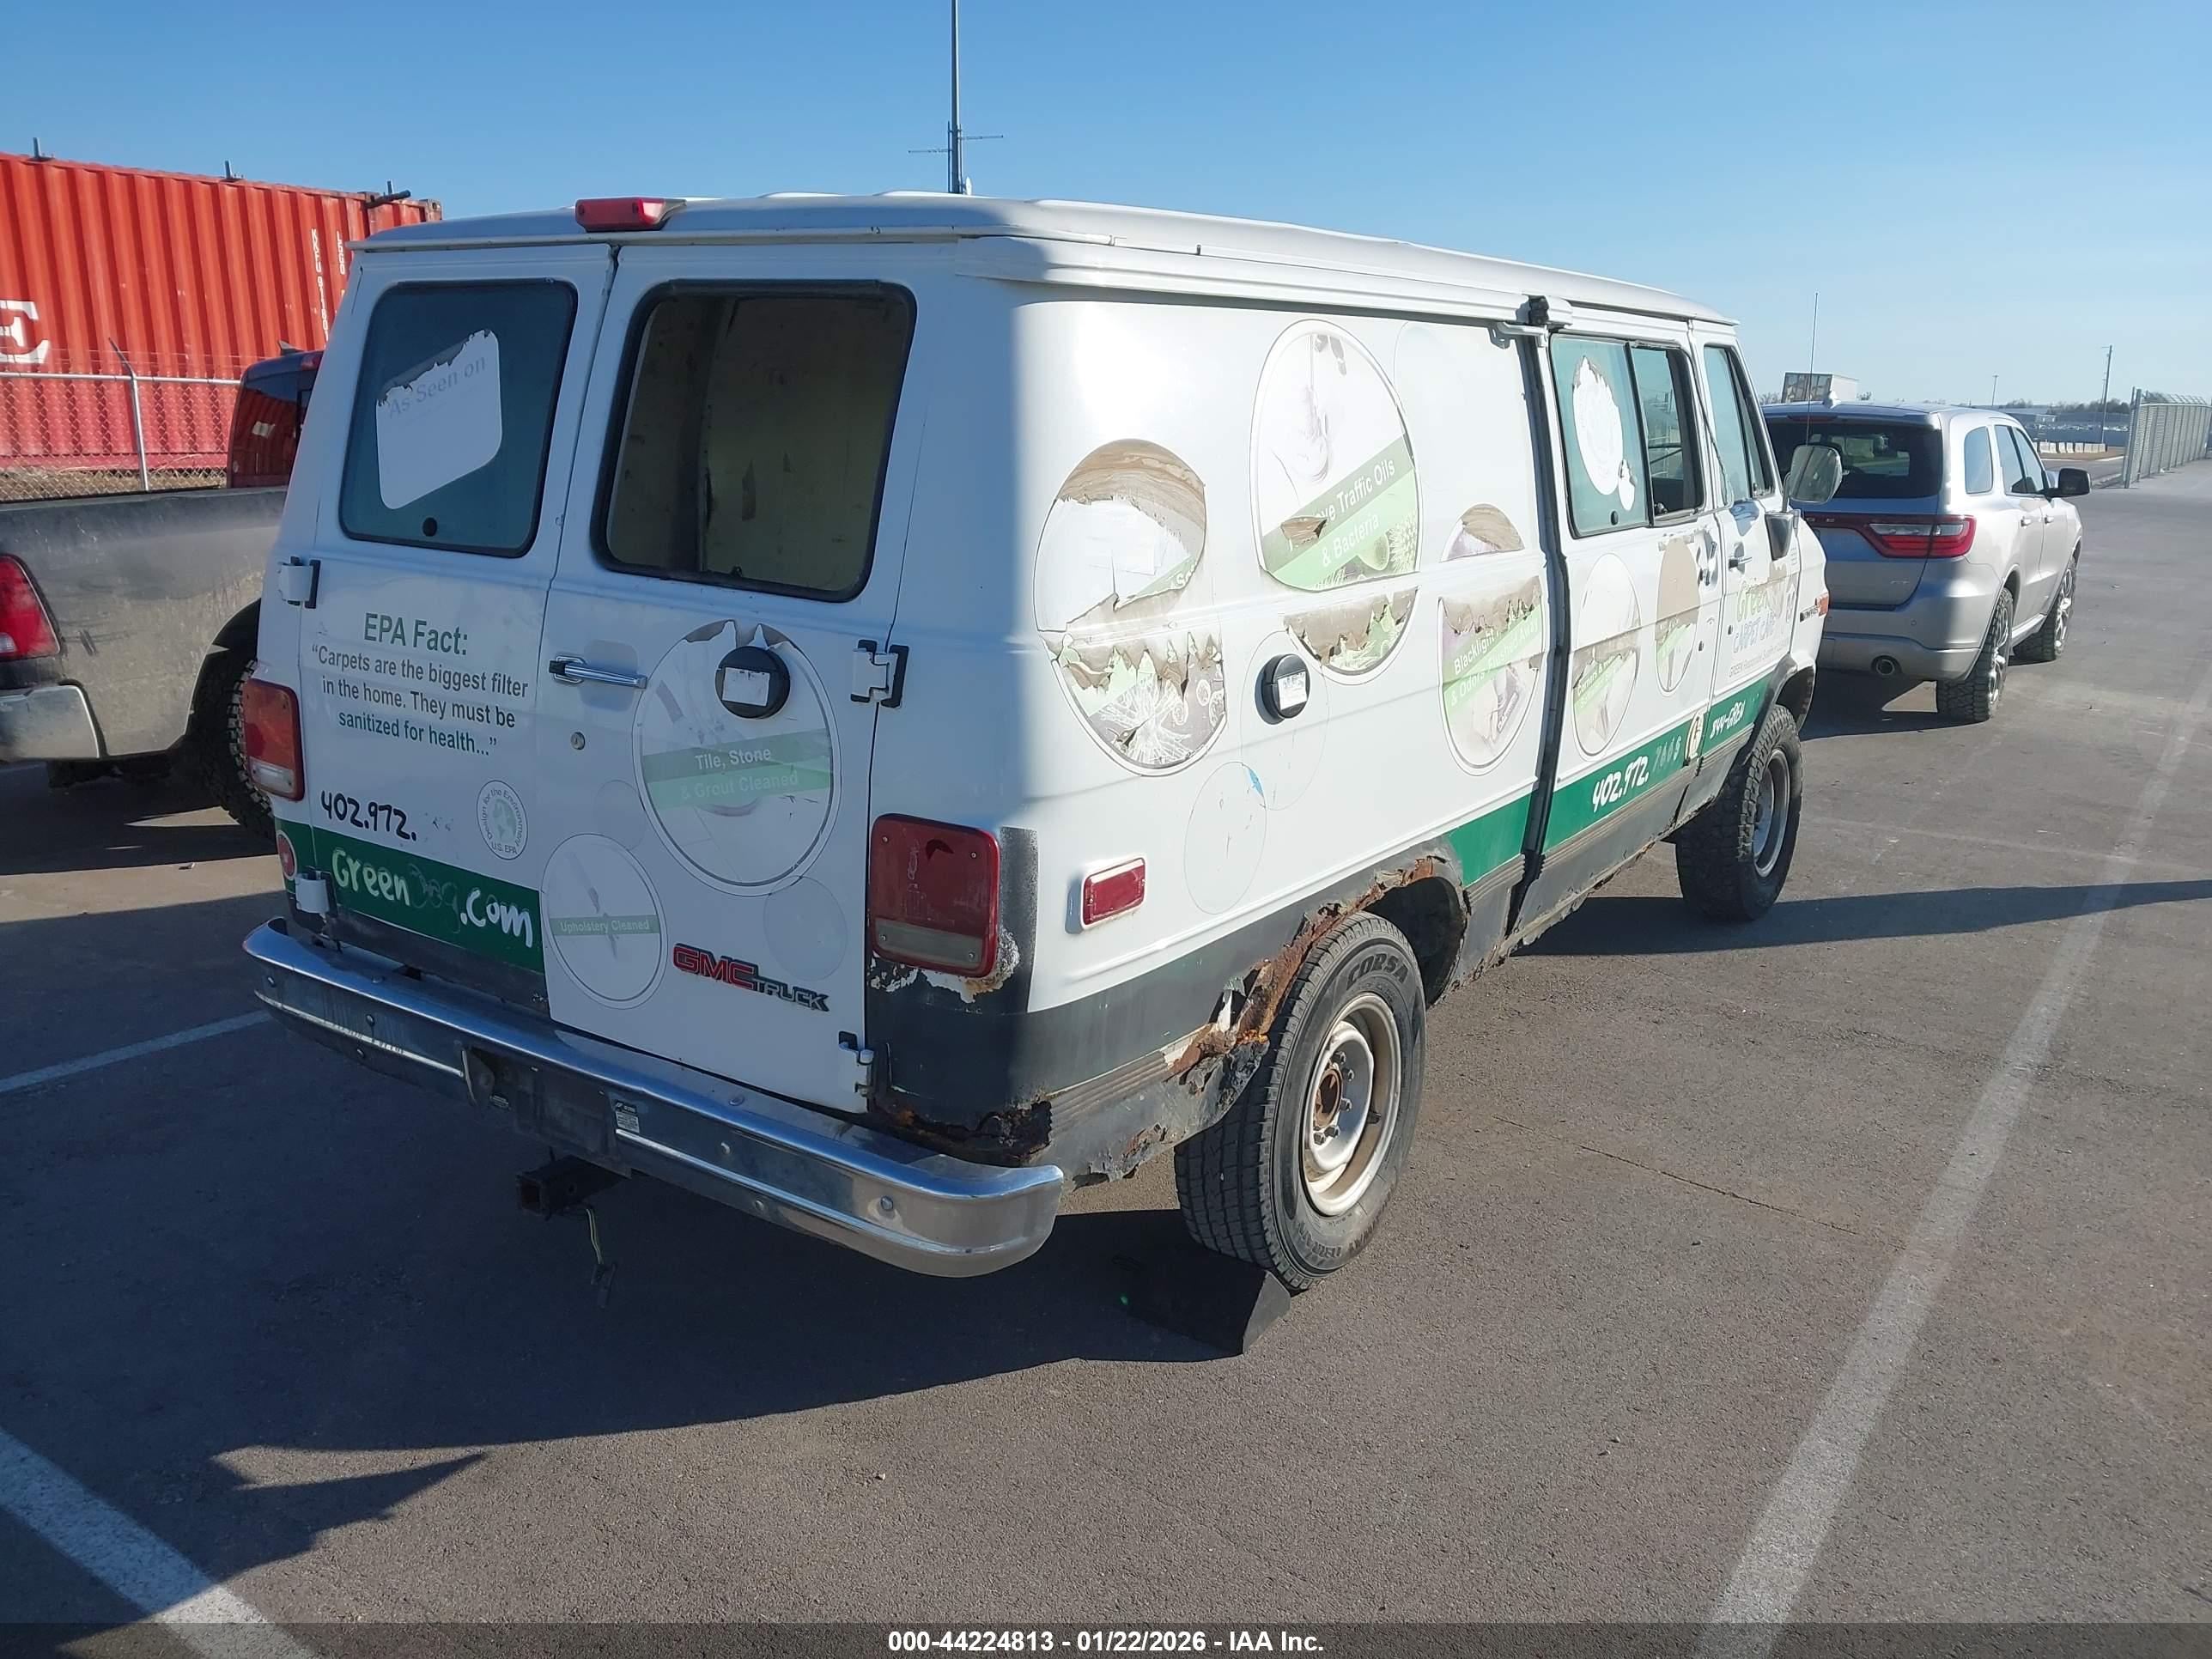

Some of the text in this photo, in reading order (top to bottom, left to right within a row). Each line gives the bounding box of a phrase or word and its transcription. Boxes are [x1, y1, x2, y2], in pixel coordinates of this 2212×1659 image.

[416, 371, 458, 403] Seen
[464, 356, 485, 378] on
[1336, 475, 1374, 513] Traffic
[1374, 459, 1395, 486] Oils
[1322, 514, 1380, 567] & Bacteria
[363, 612, 468, 655] EPA Fact:
[1454, 628, 1496, 675] Blacklight
[312, 644, 529, 697] “Carpets are the biggest filter
[322, 676, 515, 728] in the home. They must be
[338, 710, 399, 738] sanitized
[404, 720, 424, 742] for
[695, 748, 771, 770] Tile, Stone
[738, 769, 798, 792] Cleaned
[504, 844, 518, 854] EPA
[560, 919, 650, 934] Upholstery Cleaned
[672, 943, 830, 1012] GMC TRUCK
[1346, 952, 1409, 990] CORSA
